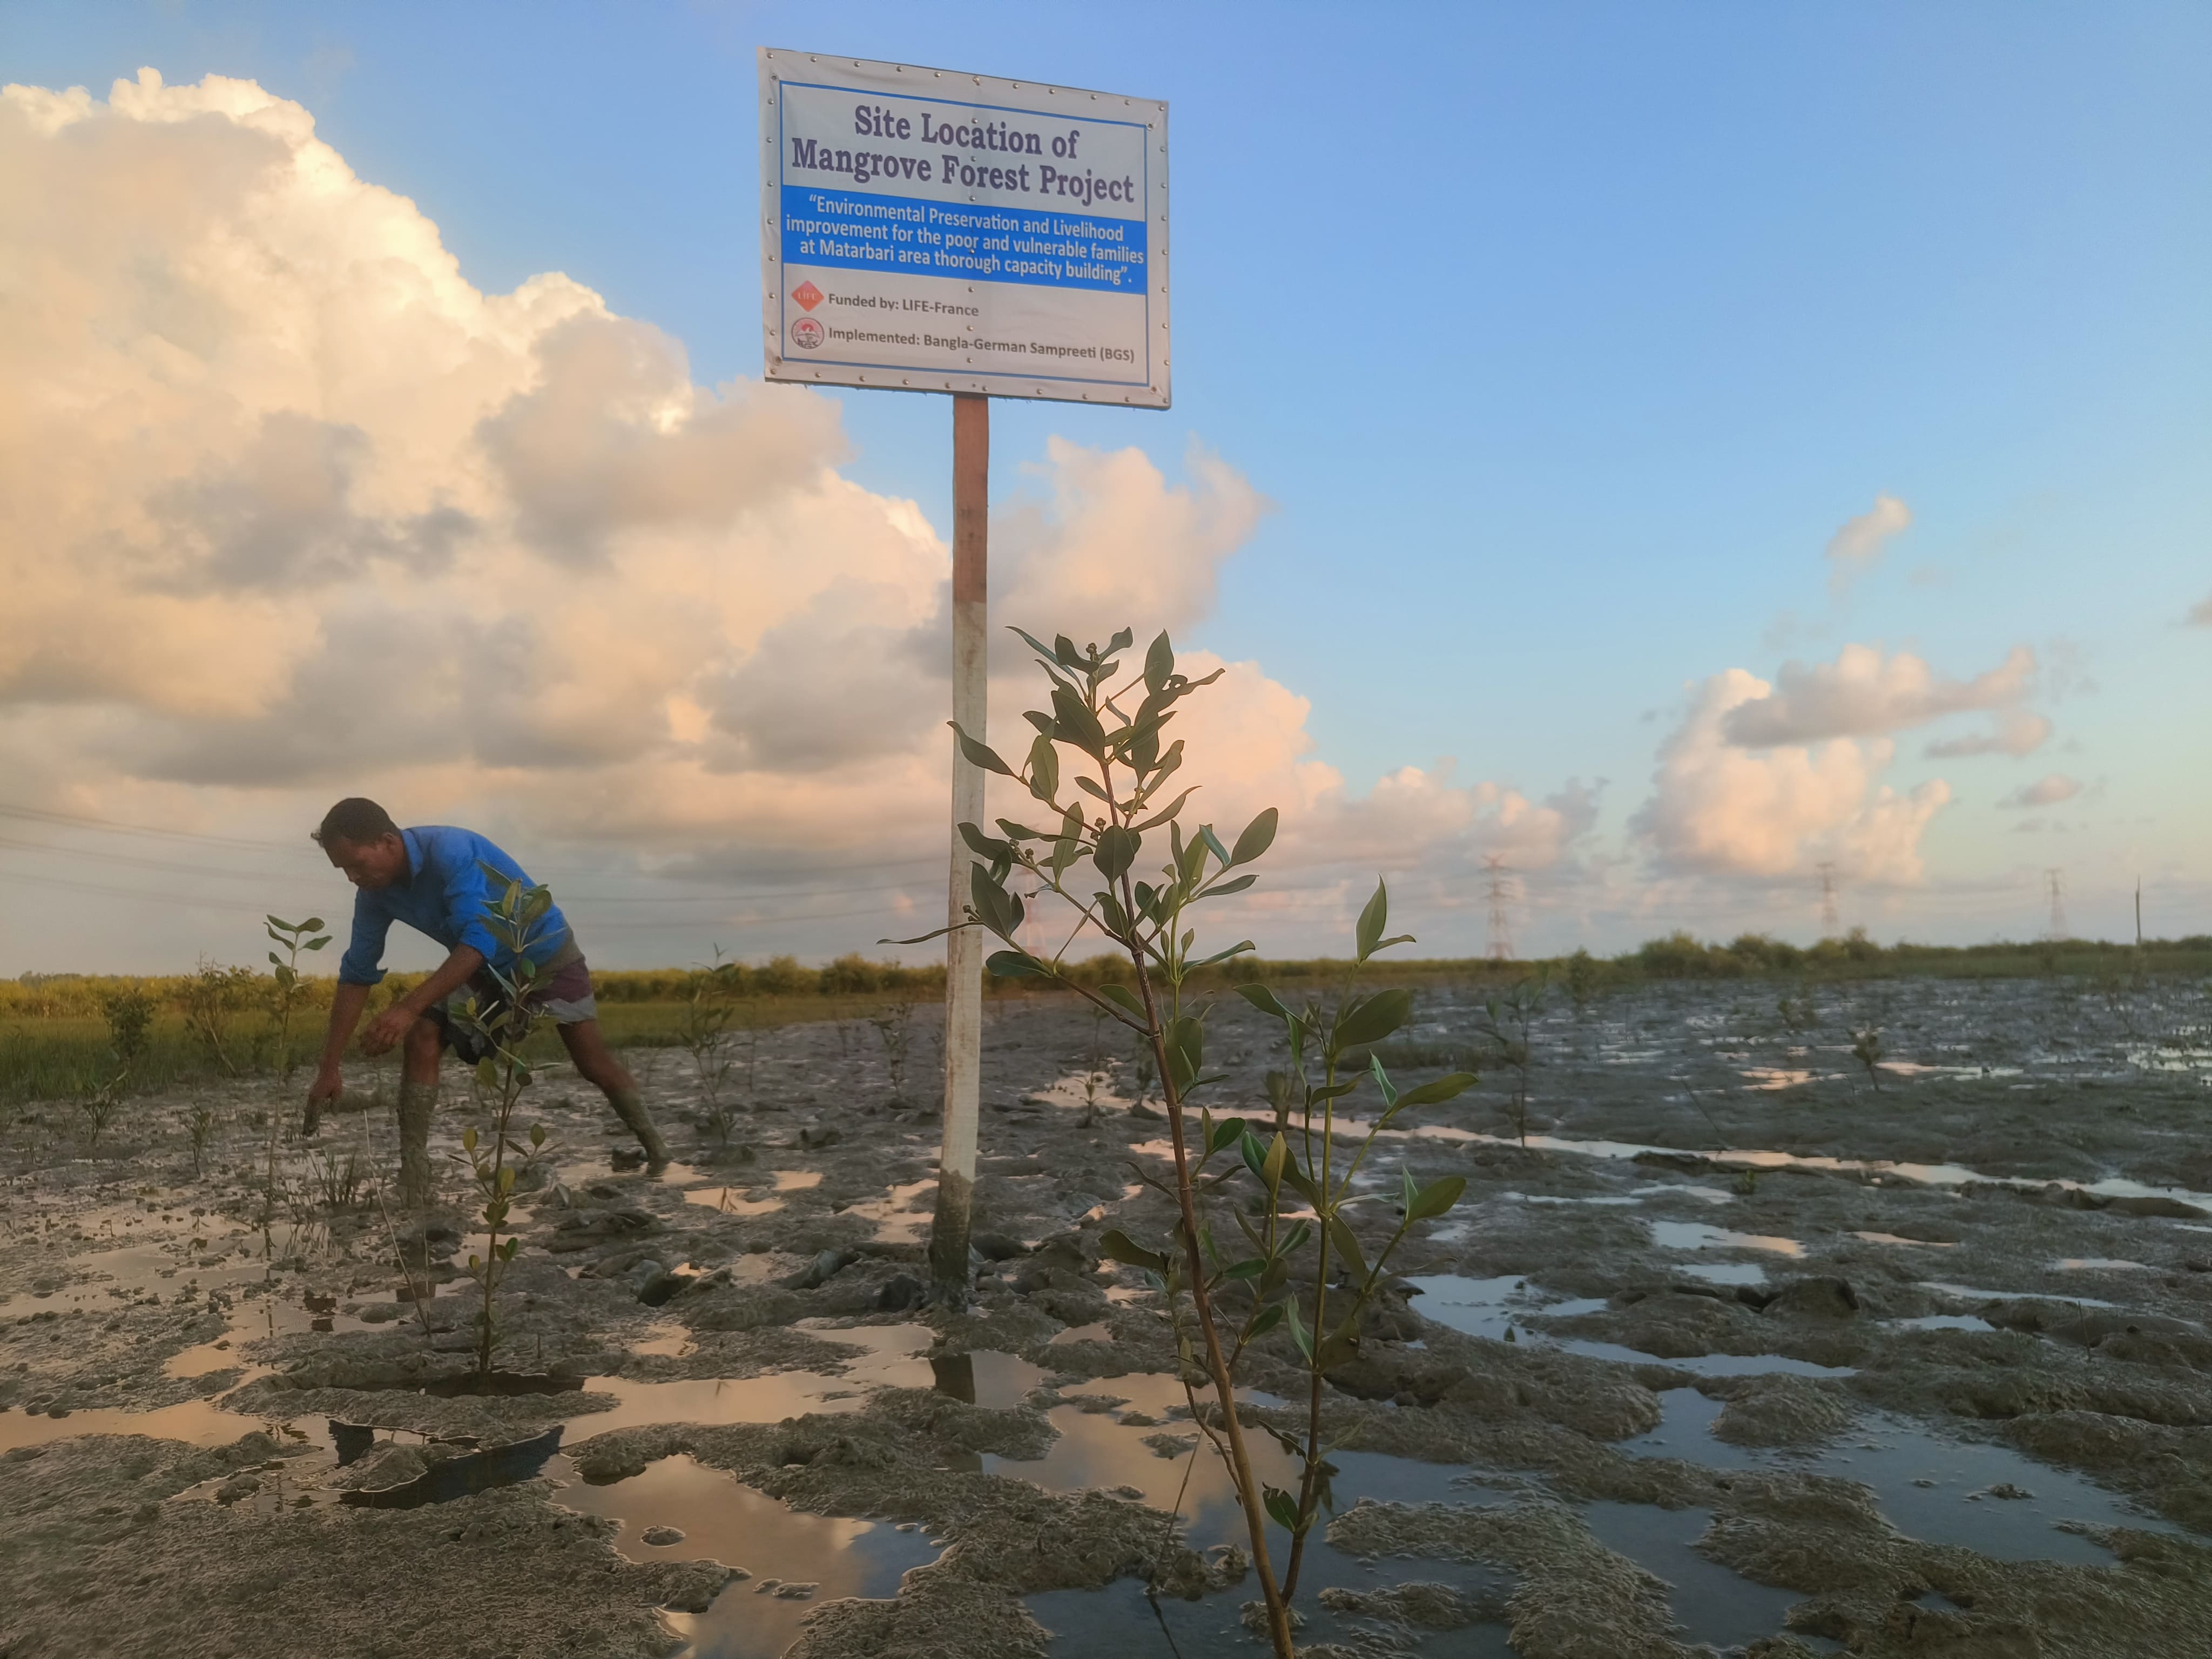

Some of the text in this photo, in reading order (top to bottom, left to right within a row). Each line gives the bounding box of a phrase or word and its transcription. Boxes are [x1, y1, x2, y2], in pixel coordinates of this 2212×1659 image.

[855, 105, 1080, 159] Site Location of
[792, 138, 1135, 207] Mangrove Forest Project
[786, 214, 1144, 264] improvement for the poor and vulnerable families
[809, 194, 1124, 241] “Environmental Preservation and Livelihood
[800, 241, 815, 254] at
[820, 239, 894, 261] Matarbari
[898, 249, 930, 265] area
[934, 250, 1000, 274] thorough
[1004, 259, 1062, 280] capacity
[829, 293, 980, 316] Funded by: LIFE-France
[829, 327, 1135, 363] Implemented: Bangla-German Sampreeti (BGS)
